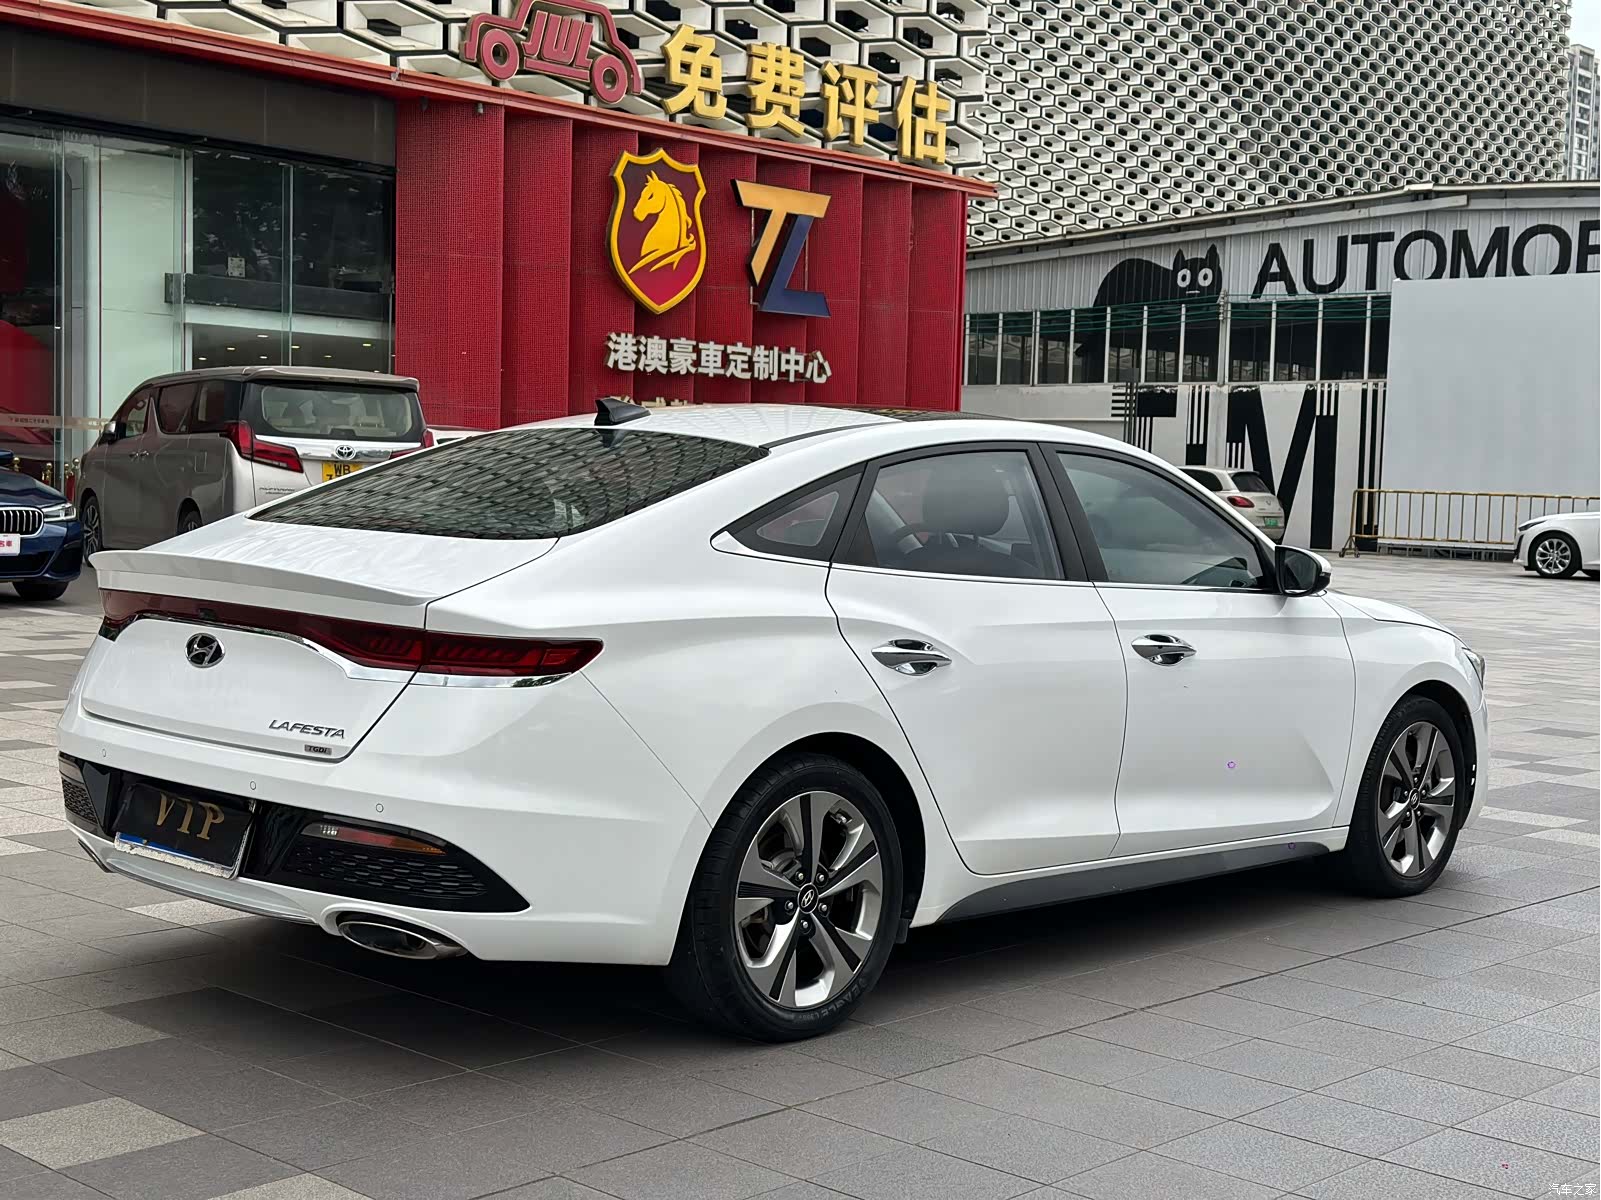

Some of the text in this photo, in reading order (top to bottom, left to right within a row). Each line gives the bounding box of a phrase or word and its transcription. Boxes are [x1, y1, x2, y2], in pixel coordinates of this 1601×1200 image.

[660, 23, 951, 165] 免费评估
[605, 331, 833, 384] 港澳豪車定制中心
[268, 719, 345, 740] LAFESTA
[156, 791, 225, 841] VIP
